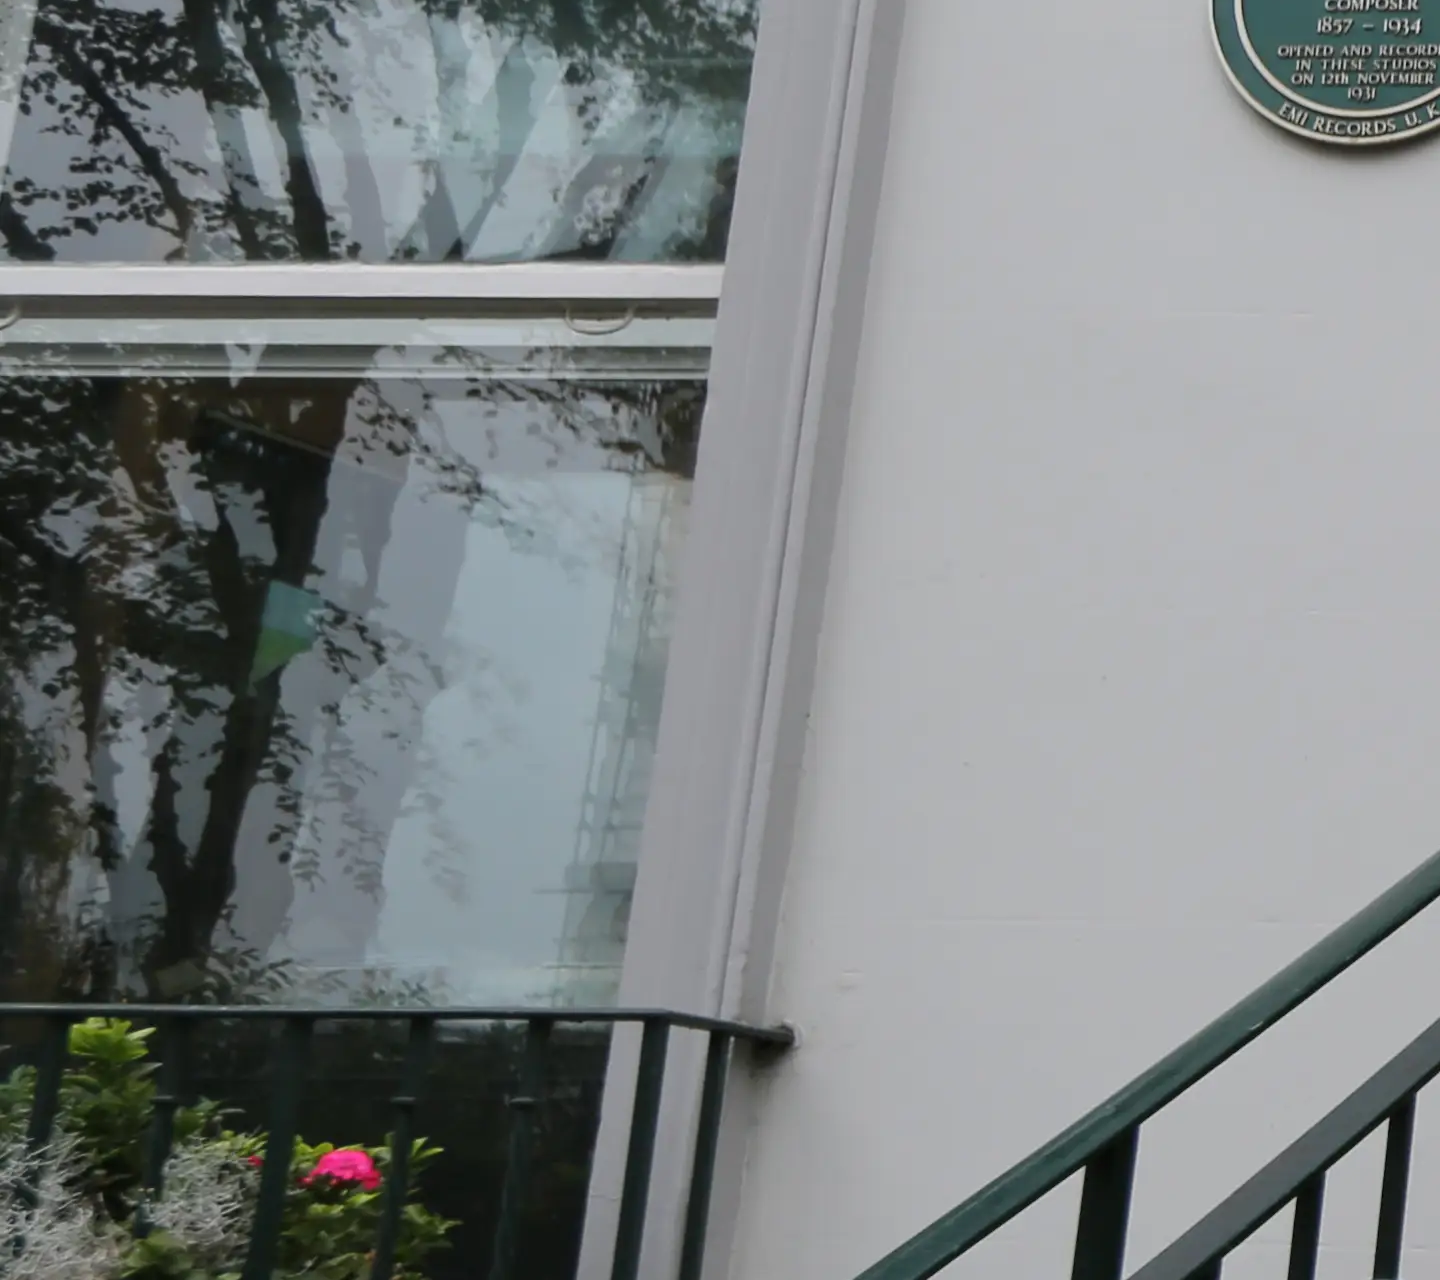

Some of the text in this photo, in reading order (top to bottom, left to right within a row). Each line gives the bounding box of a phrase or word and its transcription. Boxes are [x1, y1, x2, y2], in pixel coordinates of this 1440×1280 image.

[1316, 16, 1354, 34] 1857
[1383, 17, 1422, 36] 1934
[1277, 44, 1334, 57] OPENED
[1340, 44, 1372, 57] AND
[1296, 58, 1437, 71] IN THESE STUDIOS
[1292, 73, 1315, 85] ON
[1357, 72, 1434, 84] NOVEMBER
[1347, 86, 1377, 101] 1931
[1278, 102, 1309, 125] EMI
[1312, 117, 1396, 136] RECORDS
